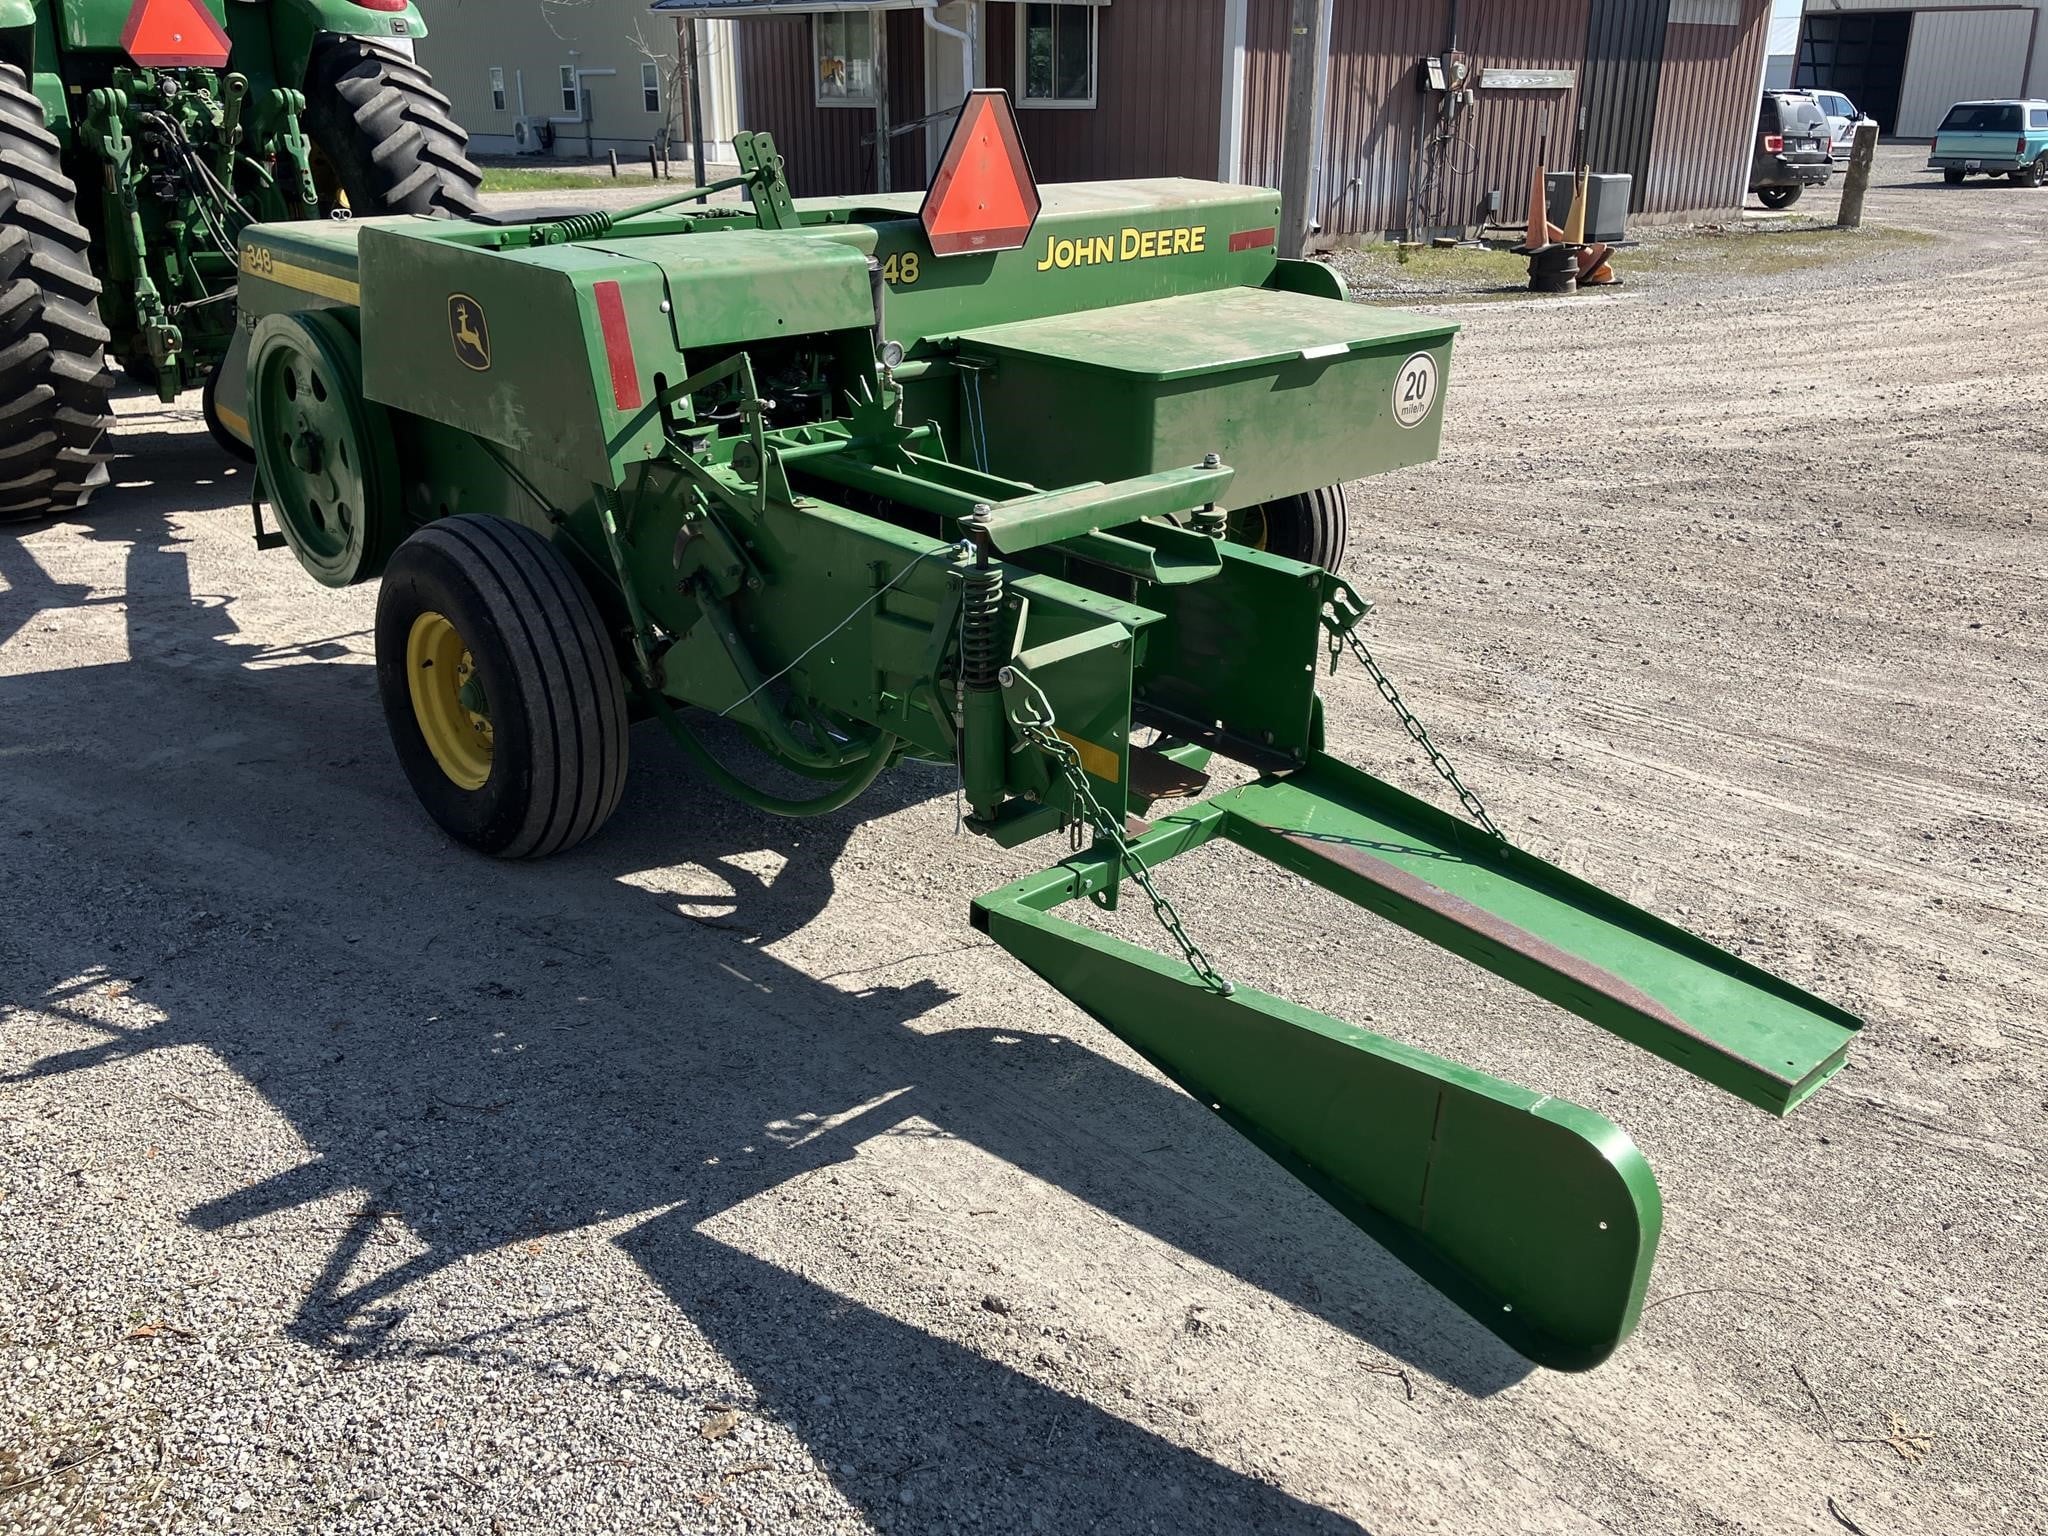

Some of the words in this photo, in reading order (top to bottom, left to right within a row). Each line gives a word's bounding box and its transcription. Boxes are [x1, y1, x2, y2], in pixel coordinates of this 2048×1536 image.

[247, 244, 272, 271] 348
[1037, 235, 1115, 271] JOHN
[1120, 226, 1207, 261] DEERE
[883, 251, 920, 284] 48
[1404, 370, 1427, 401] 20
[1401, 402, 1425, 415] mile/h
